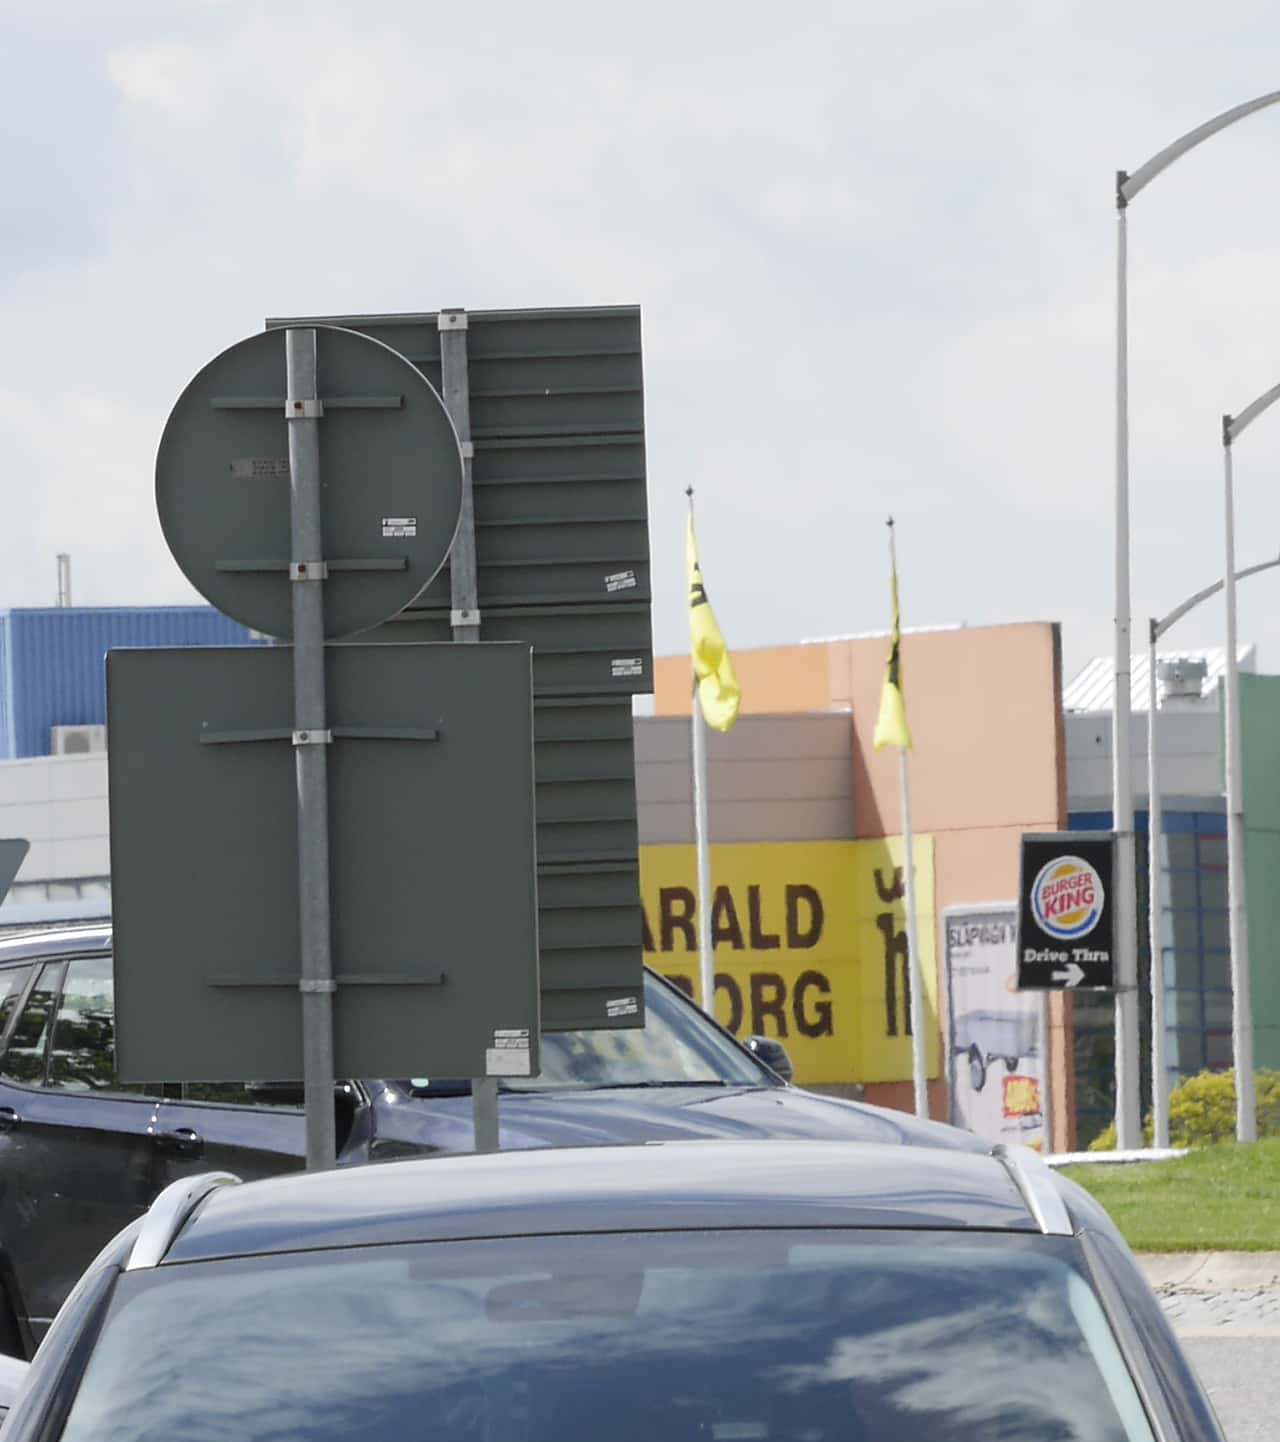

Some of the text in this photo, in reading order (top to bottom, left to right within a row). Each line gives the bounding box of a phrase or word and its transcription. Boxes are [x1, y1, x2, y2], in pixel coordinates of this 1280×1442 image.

[1041, 872, 1094, 899] BURGER
[1043, 887, 1096, 919] KING
[1023, 948, 1110, 962] Drive Thru
[664, 970, 834, 1038] ORG
